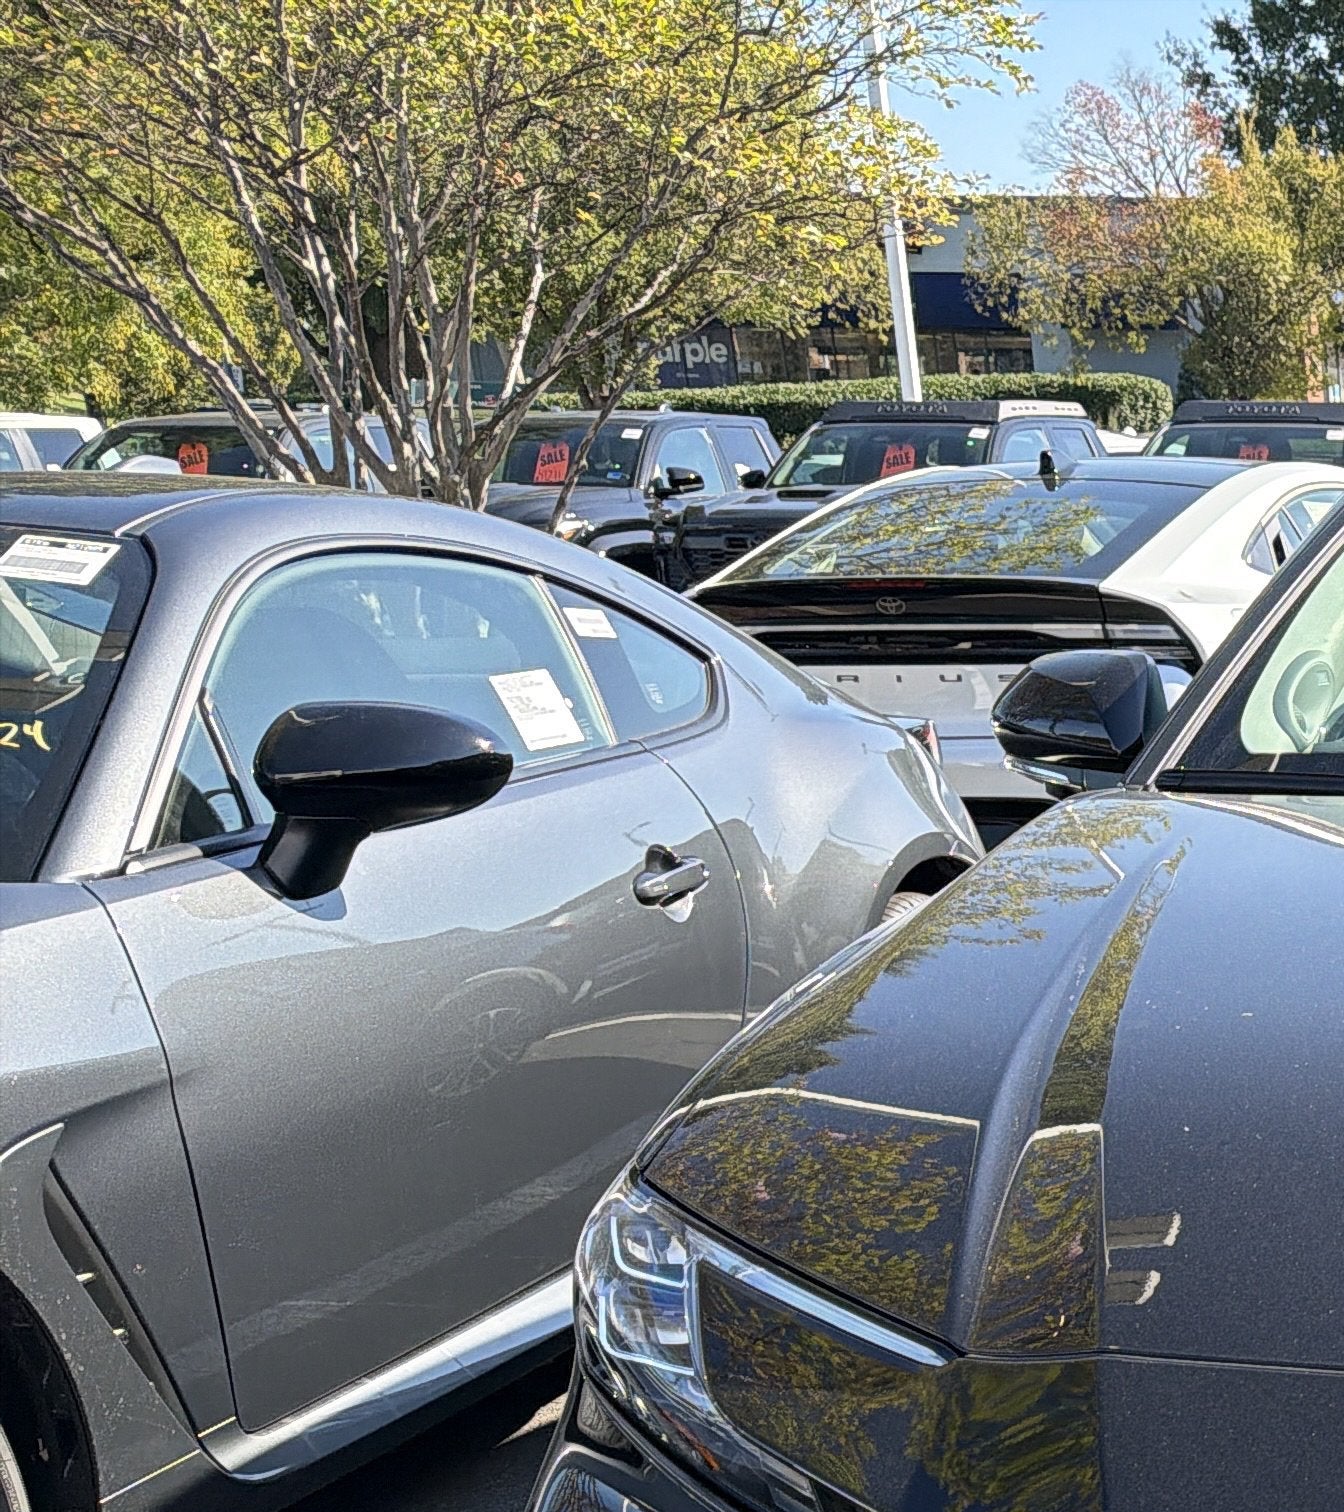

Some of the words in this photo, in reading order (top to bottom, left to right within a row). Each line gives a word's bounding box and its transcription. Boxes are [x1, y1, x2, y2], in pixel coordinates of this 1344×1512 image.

[654, 336, 728, 368] urple
[180, 450, 205, 469] SALE
[540, 449, 566, 467] SALE
[885, 452, 911, 469] SALE
